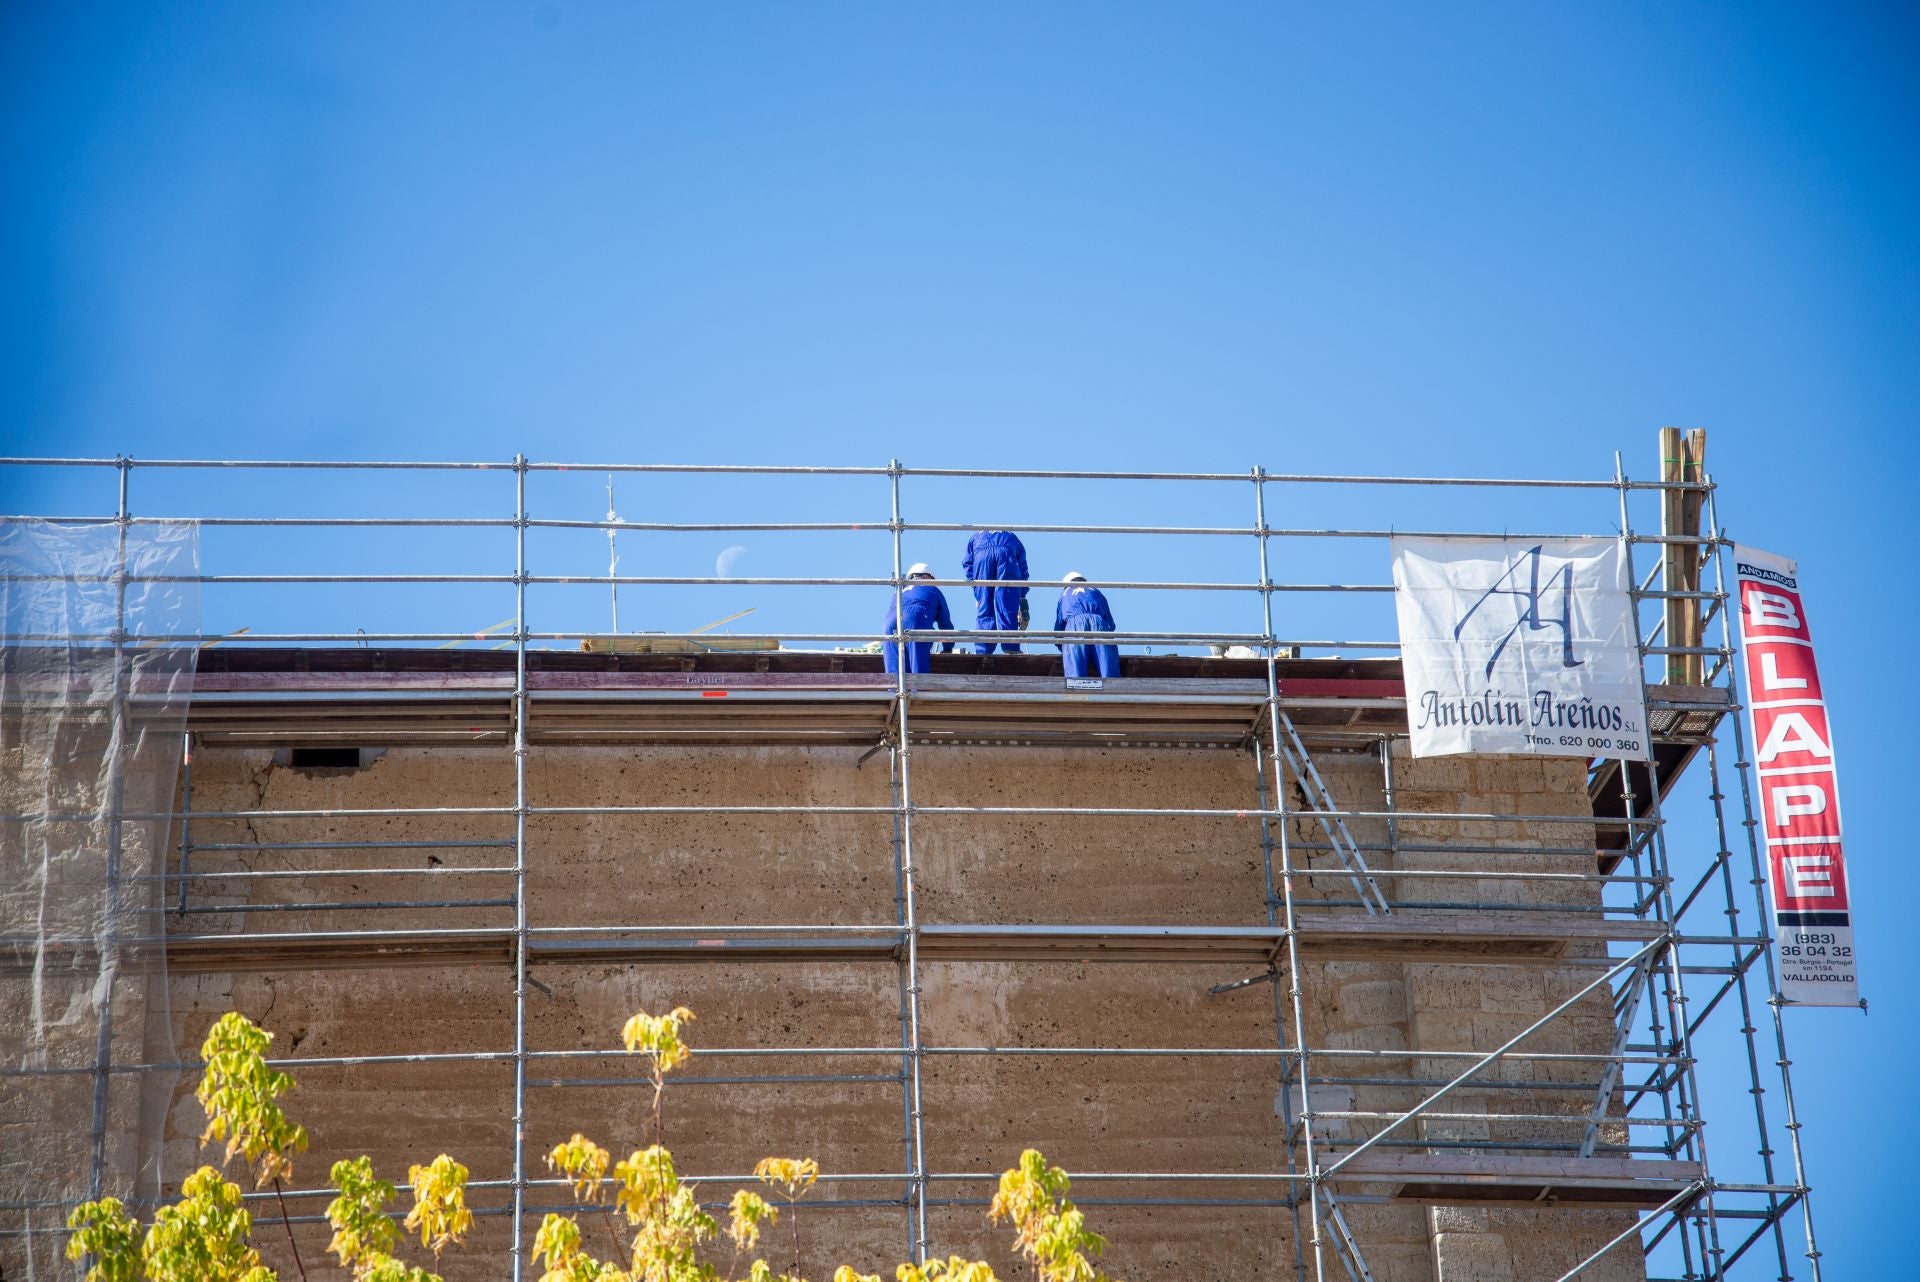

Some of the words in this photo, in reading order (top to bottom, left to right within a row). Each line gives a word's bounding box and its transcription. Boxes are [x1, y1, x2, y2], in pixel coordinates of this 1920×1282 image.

[1739, 565, 1796, 588] ANDAMIOS
[1531, 690, 1622, 731] Areños
[1524, 734, 1554, 745] Tfno.
[1559, 736, 1582, 746] 620
[1587, 737, 1612, 749] 000
[1616, 739, 1640, 751] 360
[1795, 933, 1836, 944] (983)
[1781, 946, 1801, 956] 36
[1806, 946, 1826, 956] 04
[1831, 946, 1852, 957] 32
[1826, 959, 1853, 967] Portugal
[1783, 974, 1855, 983] VALLADOLID
